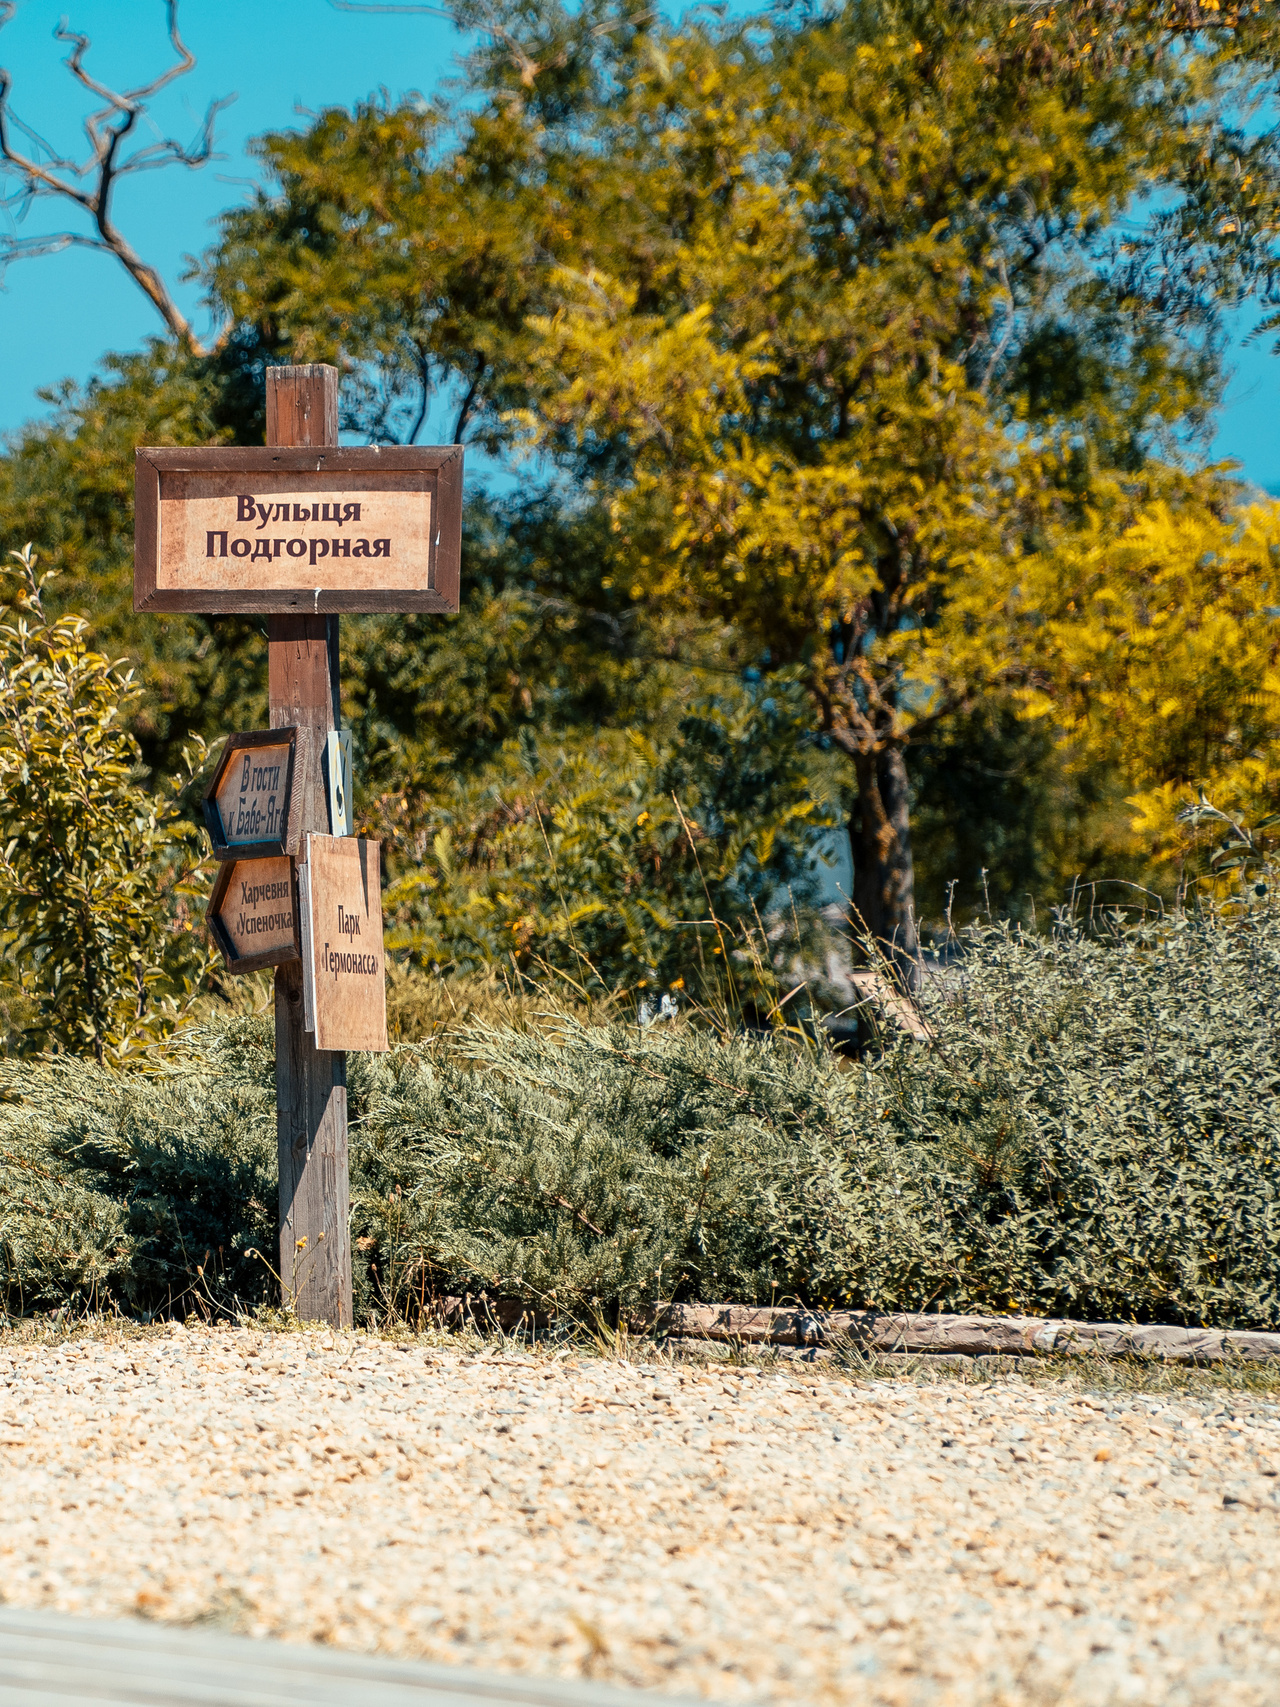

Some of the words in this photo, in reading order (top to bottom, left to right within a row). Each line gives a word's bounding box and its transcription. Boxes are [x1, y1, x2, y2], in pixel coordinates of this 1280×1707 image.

[236, 494, 361, 530] Вулыця
[205, 530, 391, 565] Подгорная
[240, 754, 251, 793] В
[251, 766, 280, 792] гости
[227, 811, 235, 836] к
[241, 881, 289, 910] Харчевня
[338, 904, 361, 943] Парк
[321, 942, 379, 981] «Гермонасса»
